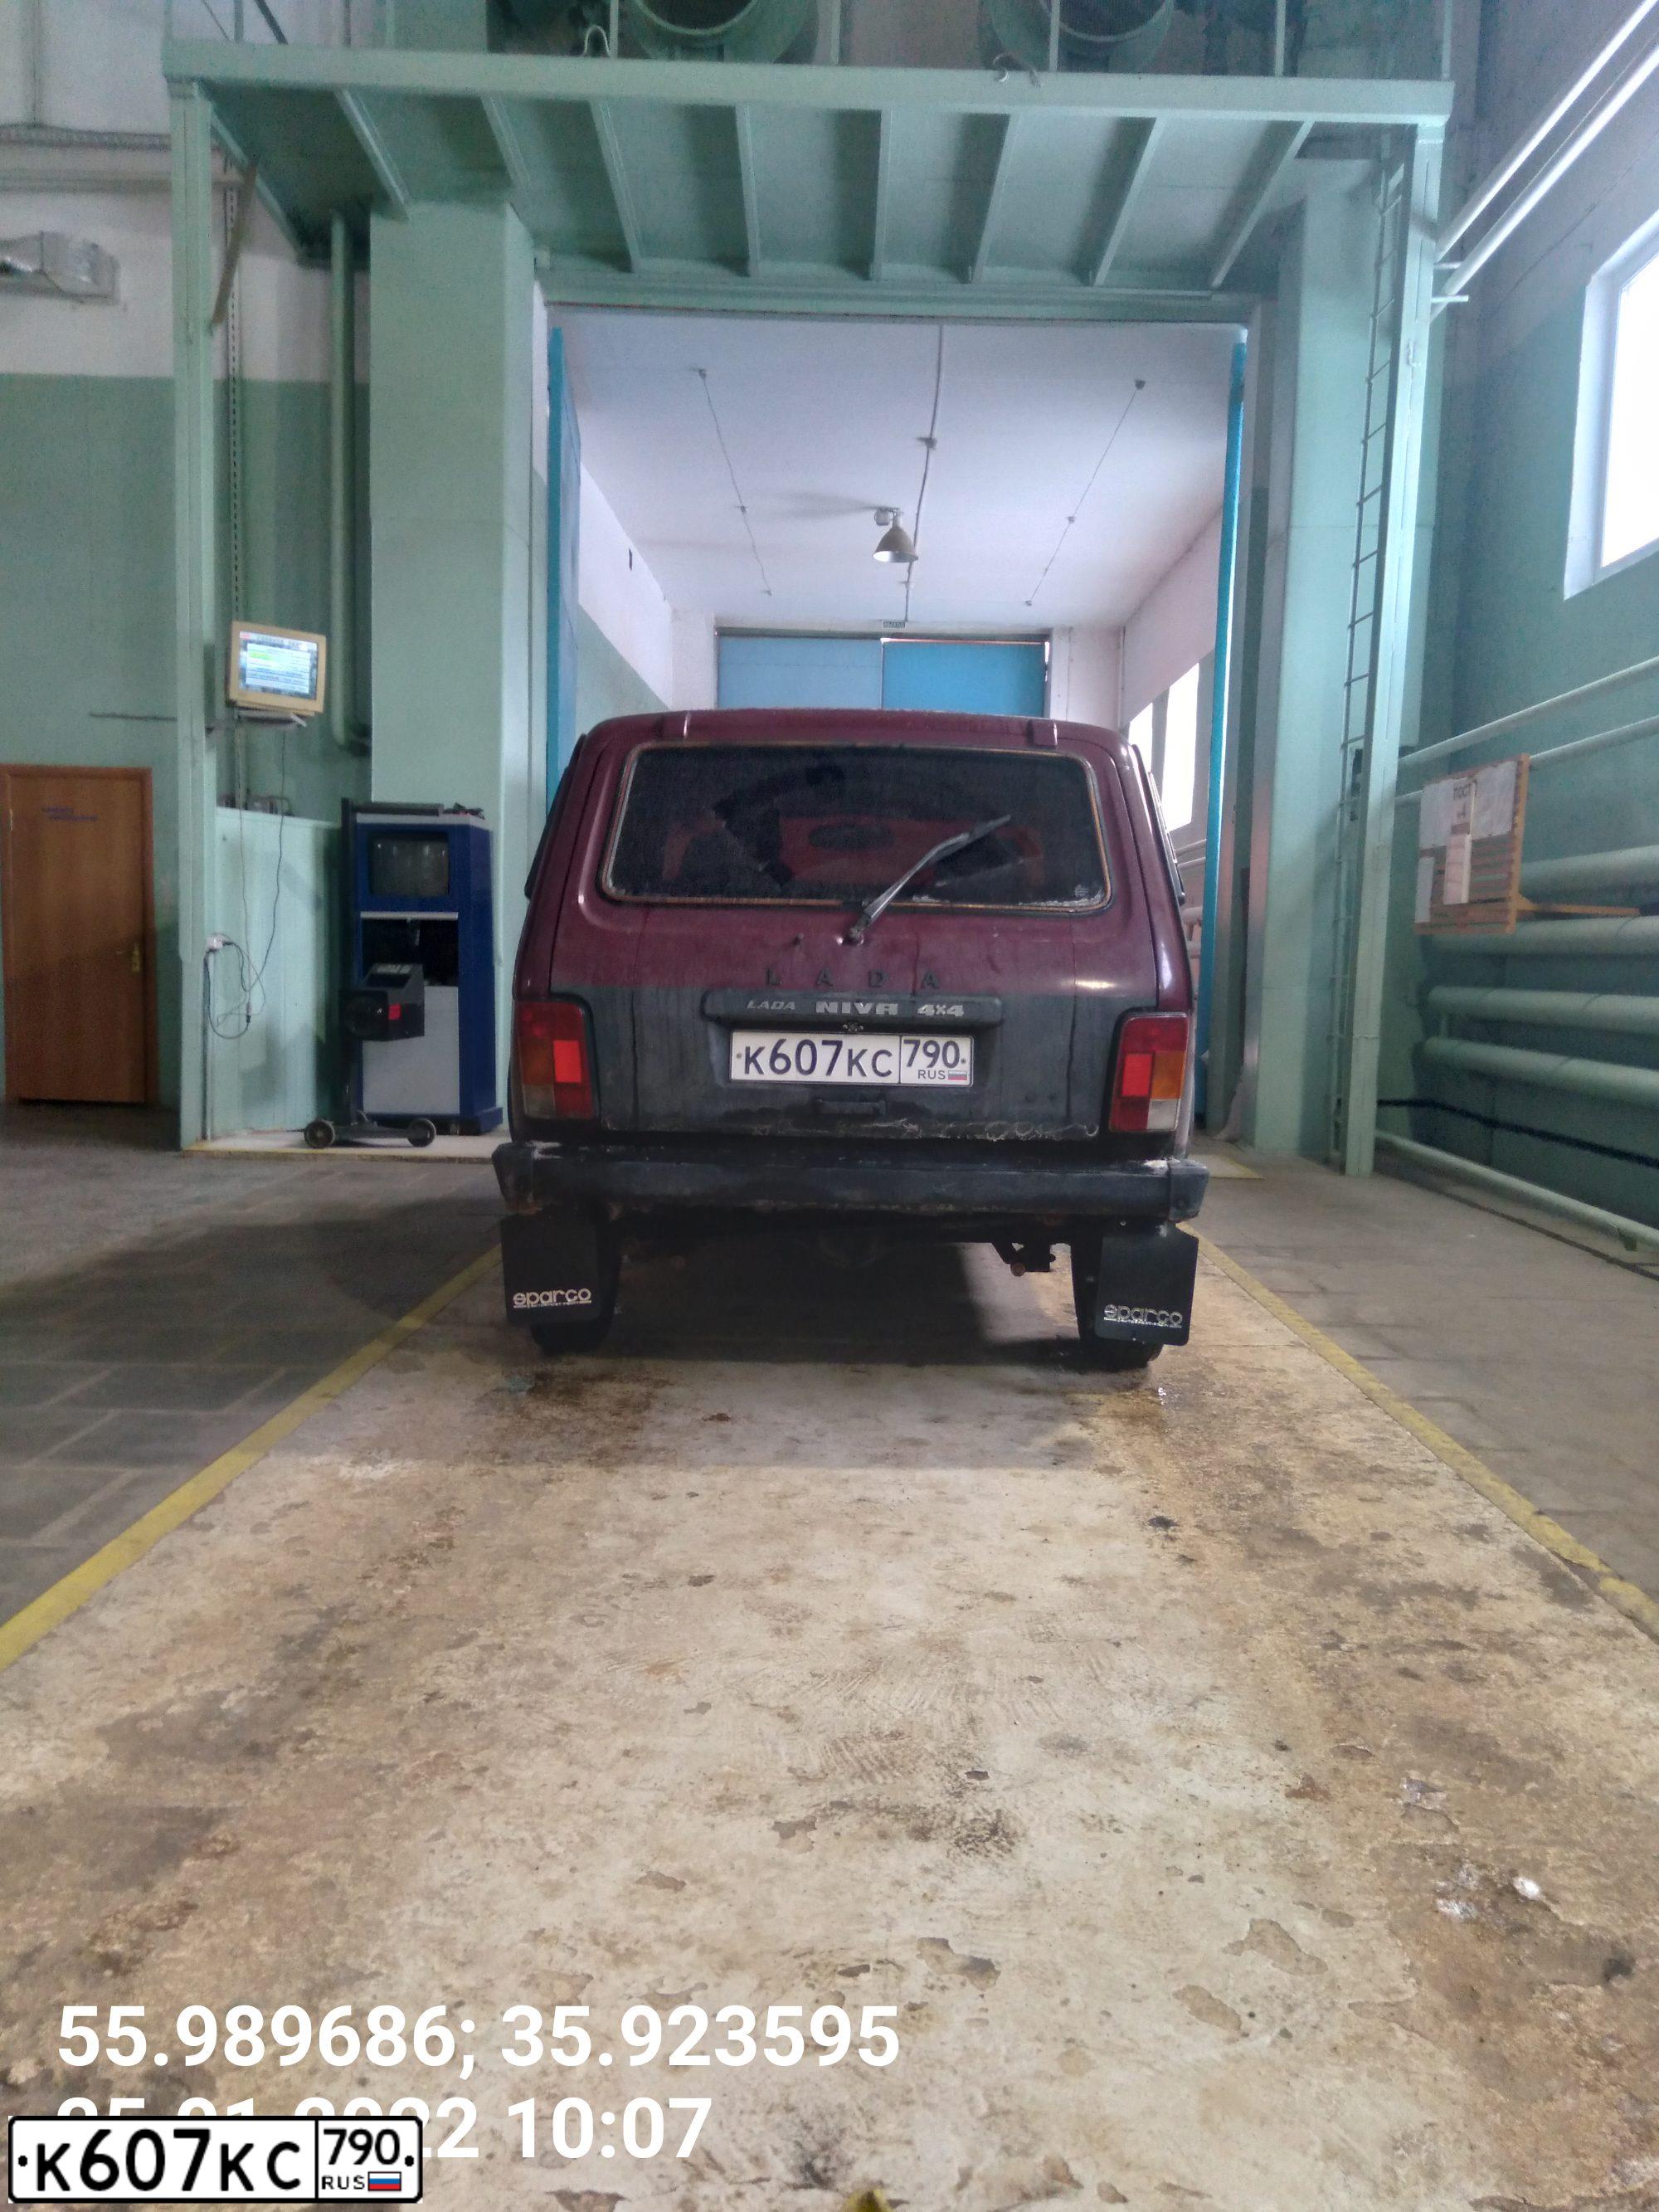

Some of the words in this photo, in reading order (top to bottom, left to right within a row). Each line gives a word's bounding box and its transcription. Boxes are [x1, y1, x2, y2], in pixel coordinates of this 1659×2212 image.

[766, 968, 938, 988] LADA
[747, 1000, 795, 1011] LADA
[815, 1001, 898, 1016] NIVA
[744, 1038, 893, 1077] К607КС
[902, 1039, 961, 1069] 790
[917, 1069, 946, 1079] RUS
